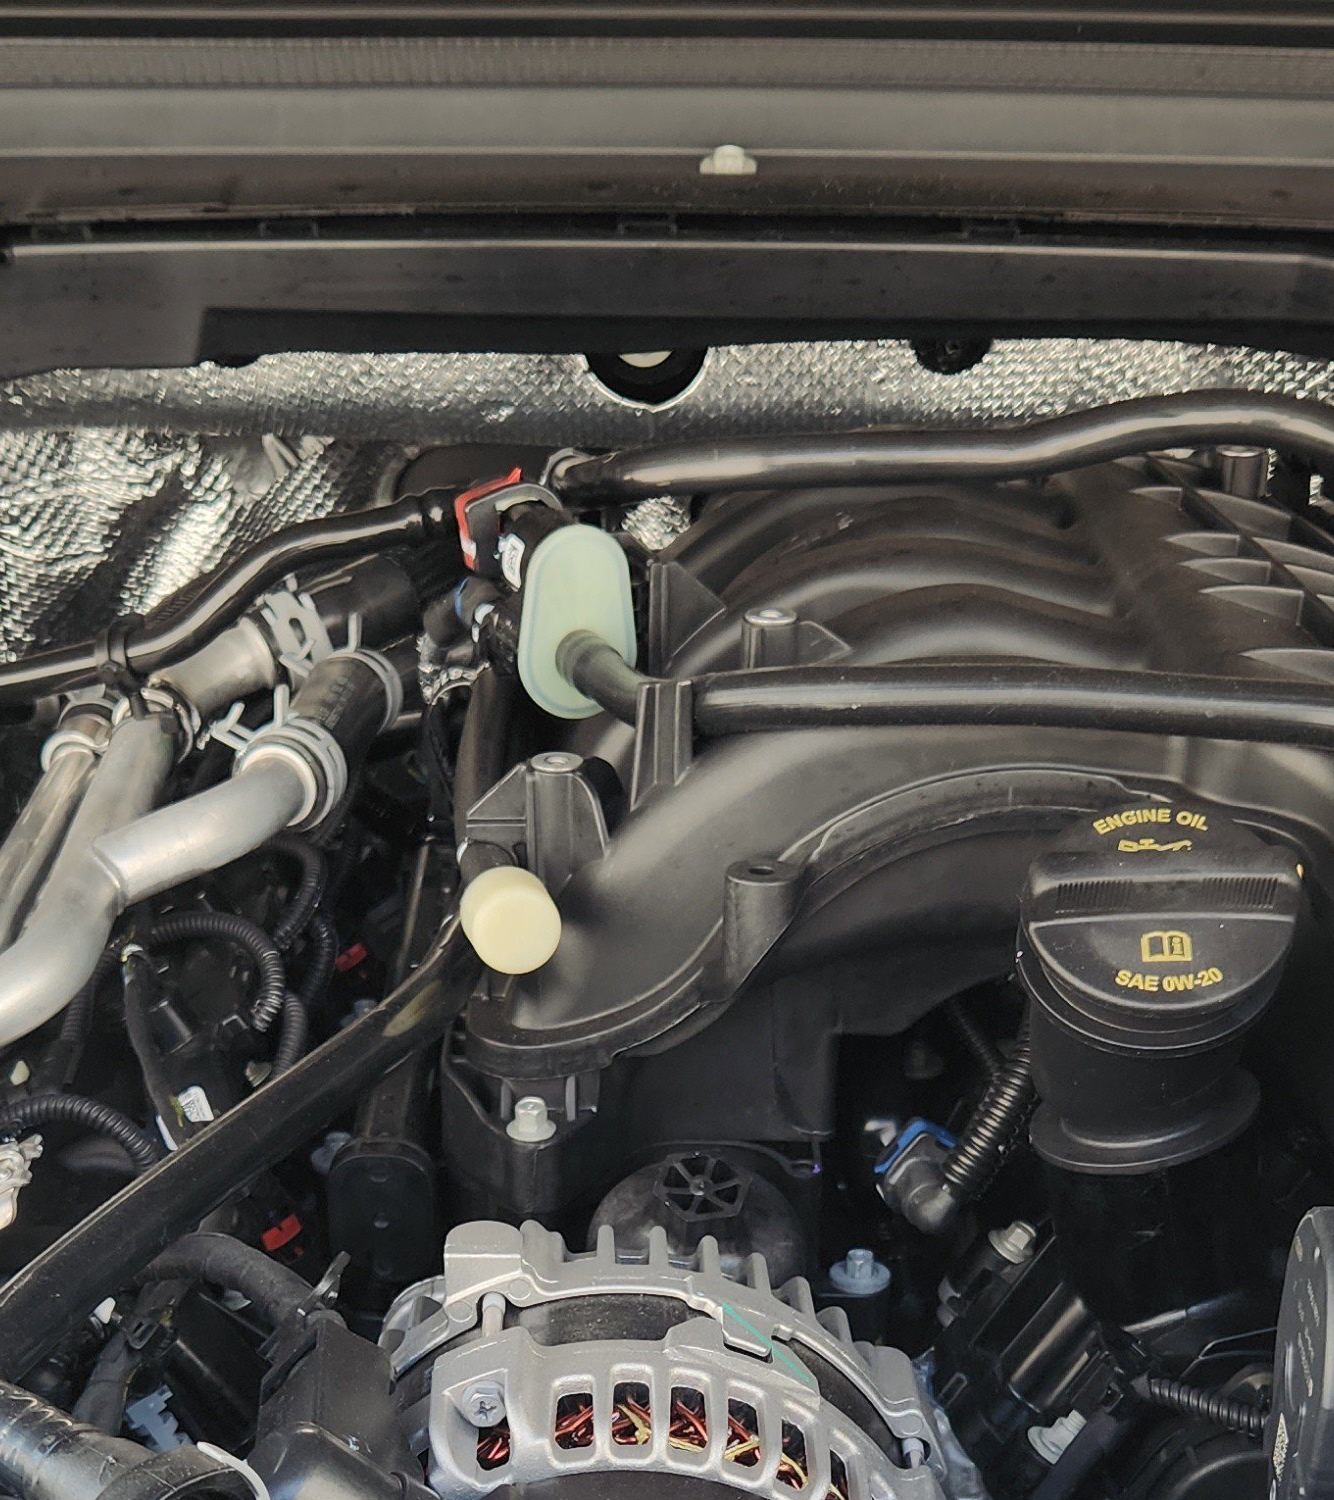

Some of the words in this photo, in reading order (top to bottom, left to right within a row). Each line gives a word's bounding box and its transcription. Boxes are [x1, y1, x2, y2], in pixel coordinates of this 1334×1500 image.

[1093, 808, 1171, 835] ENGINE
[1176, 810, 1209, 831] OIL
[1115, 969, 1159, 992] SAE
[1163, 967, 1224, 992] 0W-20
